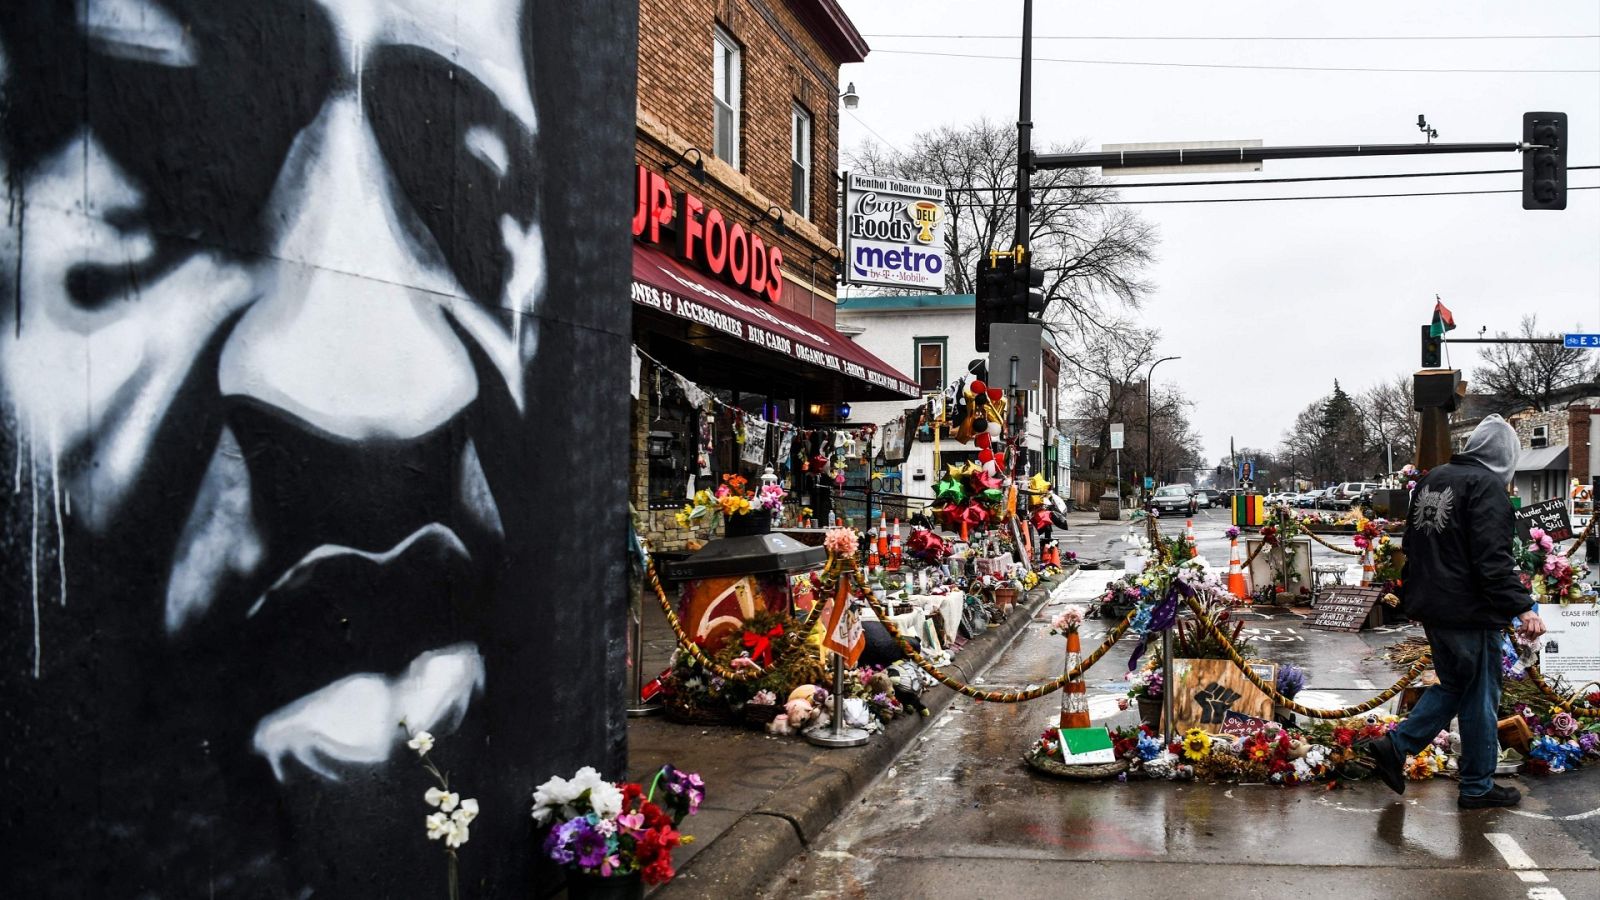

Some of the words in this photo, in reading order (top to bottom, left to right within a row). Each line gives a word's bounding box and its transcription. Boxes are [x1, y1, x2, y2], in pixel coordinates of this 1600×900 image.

[855, 177, 887, 190] Menthol
[890, 181, 921, 194] Tobacco
[923, 184, 942, 197] Shop
[859, 193, 906, 222] Cup
[916, 208, 936, 222] DELI
[853, 215, 911, 240] Foods
[685, 192, 783, 304] FOODS
[857, 246, 942, 273] metro
[662, 291, 672, 311] &
[676, 297, 742, 337] ACCESSORIES
[748, 324, 765, 345] BUS
[765, 332, 791, 354] CARDS
[795, 343, 825, 366] ORGANIC
[825, 352, 840, 370] MILK
[1580, 336, 1587, 345] E
[1592, 336, 1600, 345] 3
[1514, 507, 1542, 519] Murder
[1543, 499, 1565, 512] With
[1531, 518, 1538, 527] A
[1540, 512, 1560, 523] Badge
[1545, 519, 1565, 531] Still
[1325, 592, 1335, 603] A
[1335, 605, 1353, 613] FORCE
